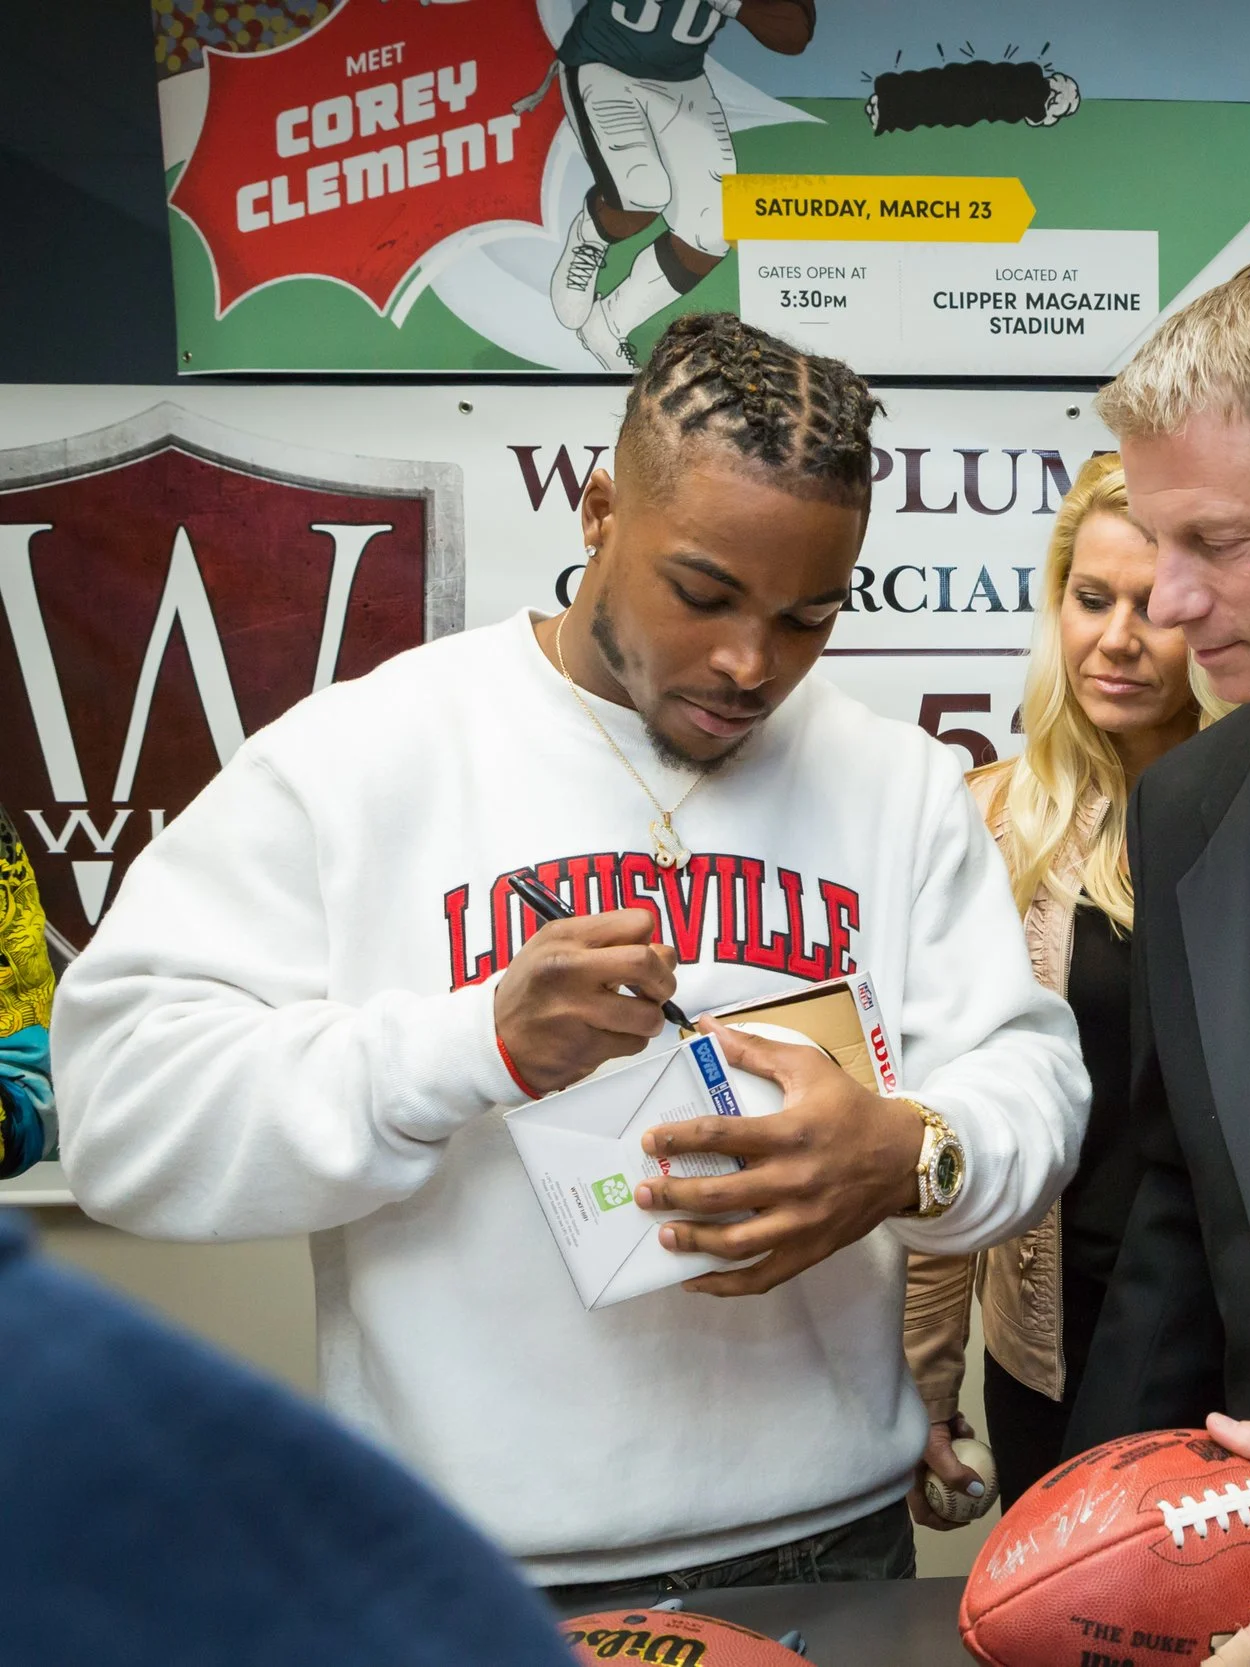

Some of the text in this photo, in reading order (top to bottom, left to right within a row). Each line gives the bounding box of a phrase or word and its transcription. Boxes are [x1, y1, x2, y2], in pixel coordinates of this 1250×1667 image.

[346, 41, 406, 77] MEET
[275, 59, 479, 159] COREY
[235, 113, 521, 233] CLEMENT
[754, 198, 993, 220] SATURDAY, MARCH 23
[758, 266, 867, 280] GATES OPEN AT
[995, 269, 1078, 281] LOCATED AT
[780, 291, 847, 309] 3:30PM
[933, 291, 1141, 311] CLIPPER MAGAZINE
[989, 316, 1085, 335] STADIUM
[918, 693, 1024, 769] 5
[723, 1091, 735, 1115] NFL
